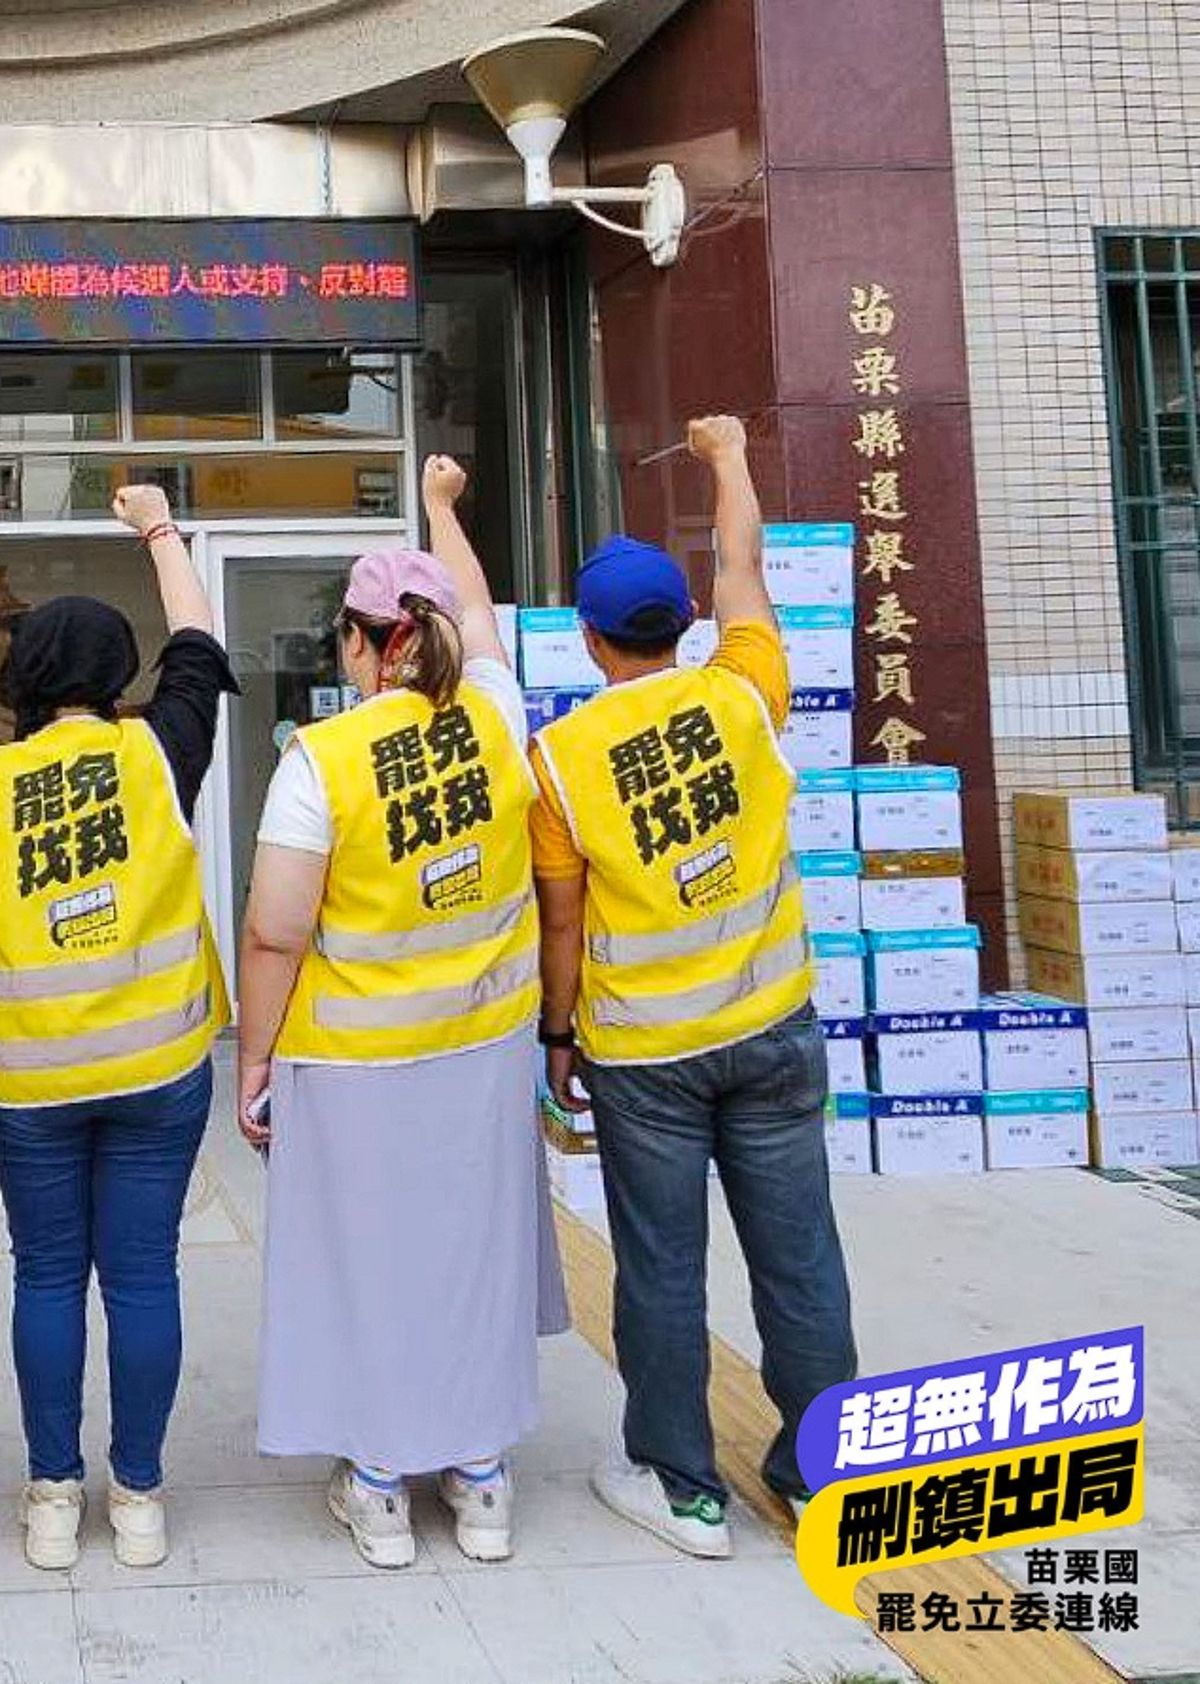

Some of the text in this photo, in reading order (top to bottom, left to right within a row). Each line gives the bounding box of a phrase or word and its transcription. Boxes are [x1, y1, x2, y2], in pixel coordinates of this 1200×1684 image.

[848, 284, 927, 764] 苗栗縣選舉委員會
[13, 752, 119, 832] 罷免
[371, 705, 480, 798] 罷免
[609, 705, 724, 805] 罷免
[17, 803, 128, 898] 找我
[386, 765, 492, 864] 找我
[631, 761, 740, 866] 找我
[950, 1014, 963, 1028] A
[1059, 1011, 1072, 1024] A
[954, 1099, 969, 1112] A
